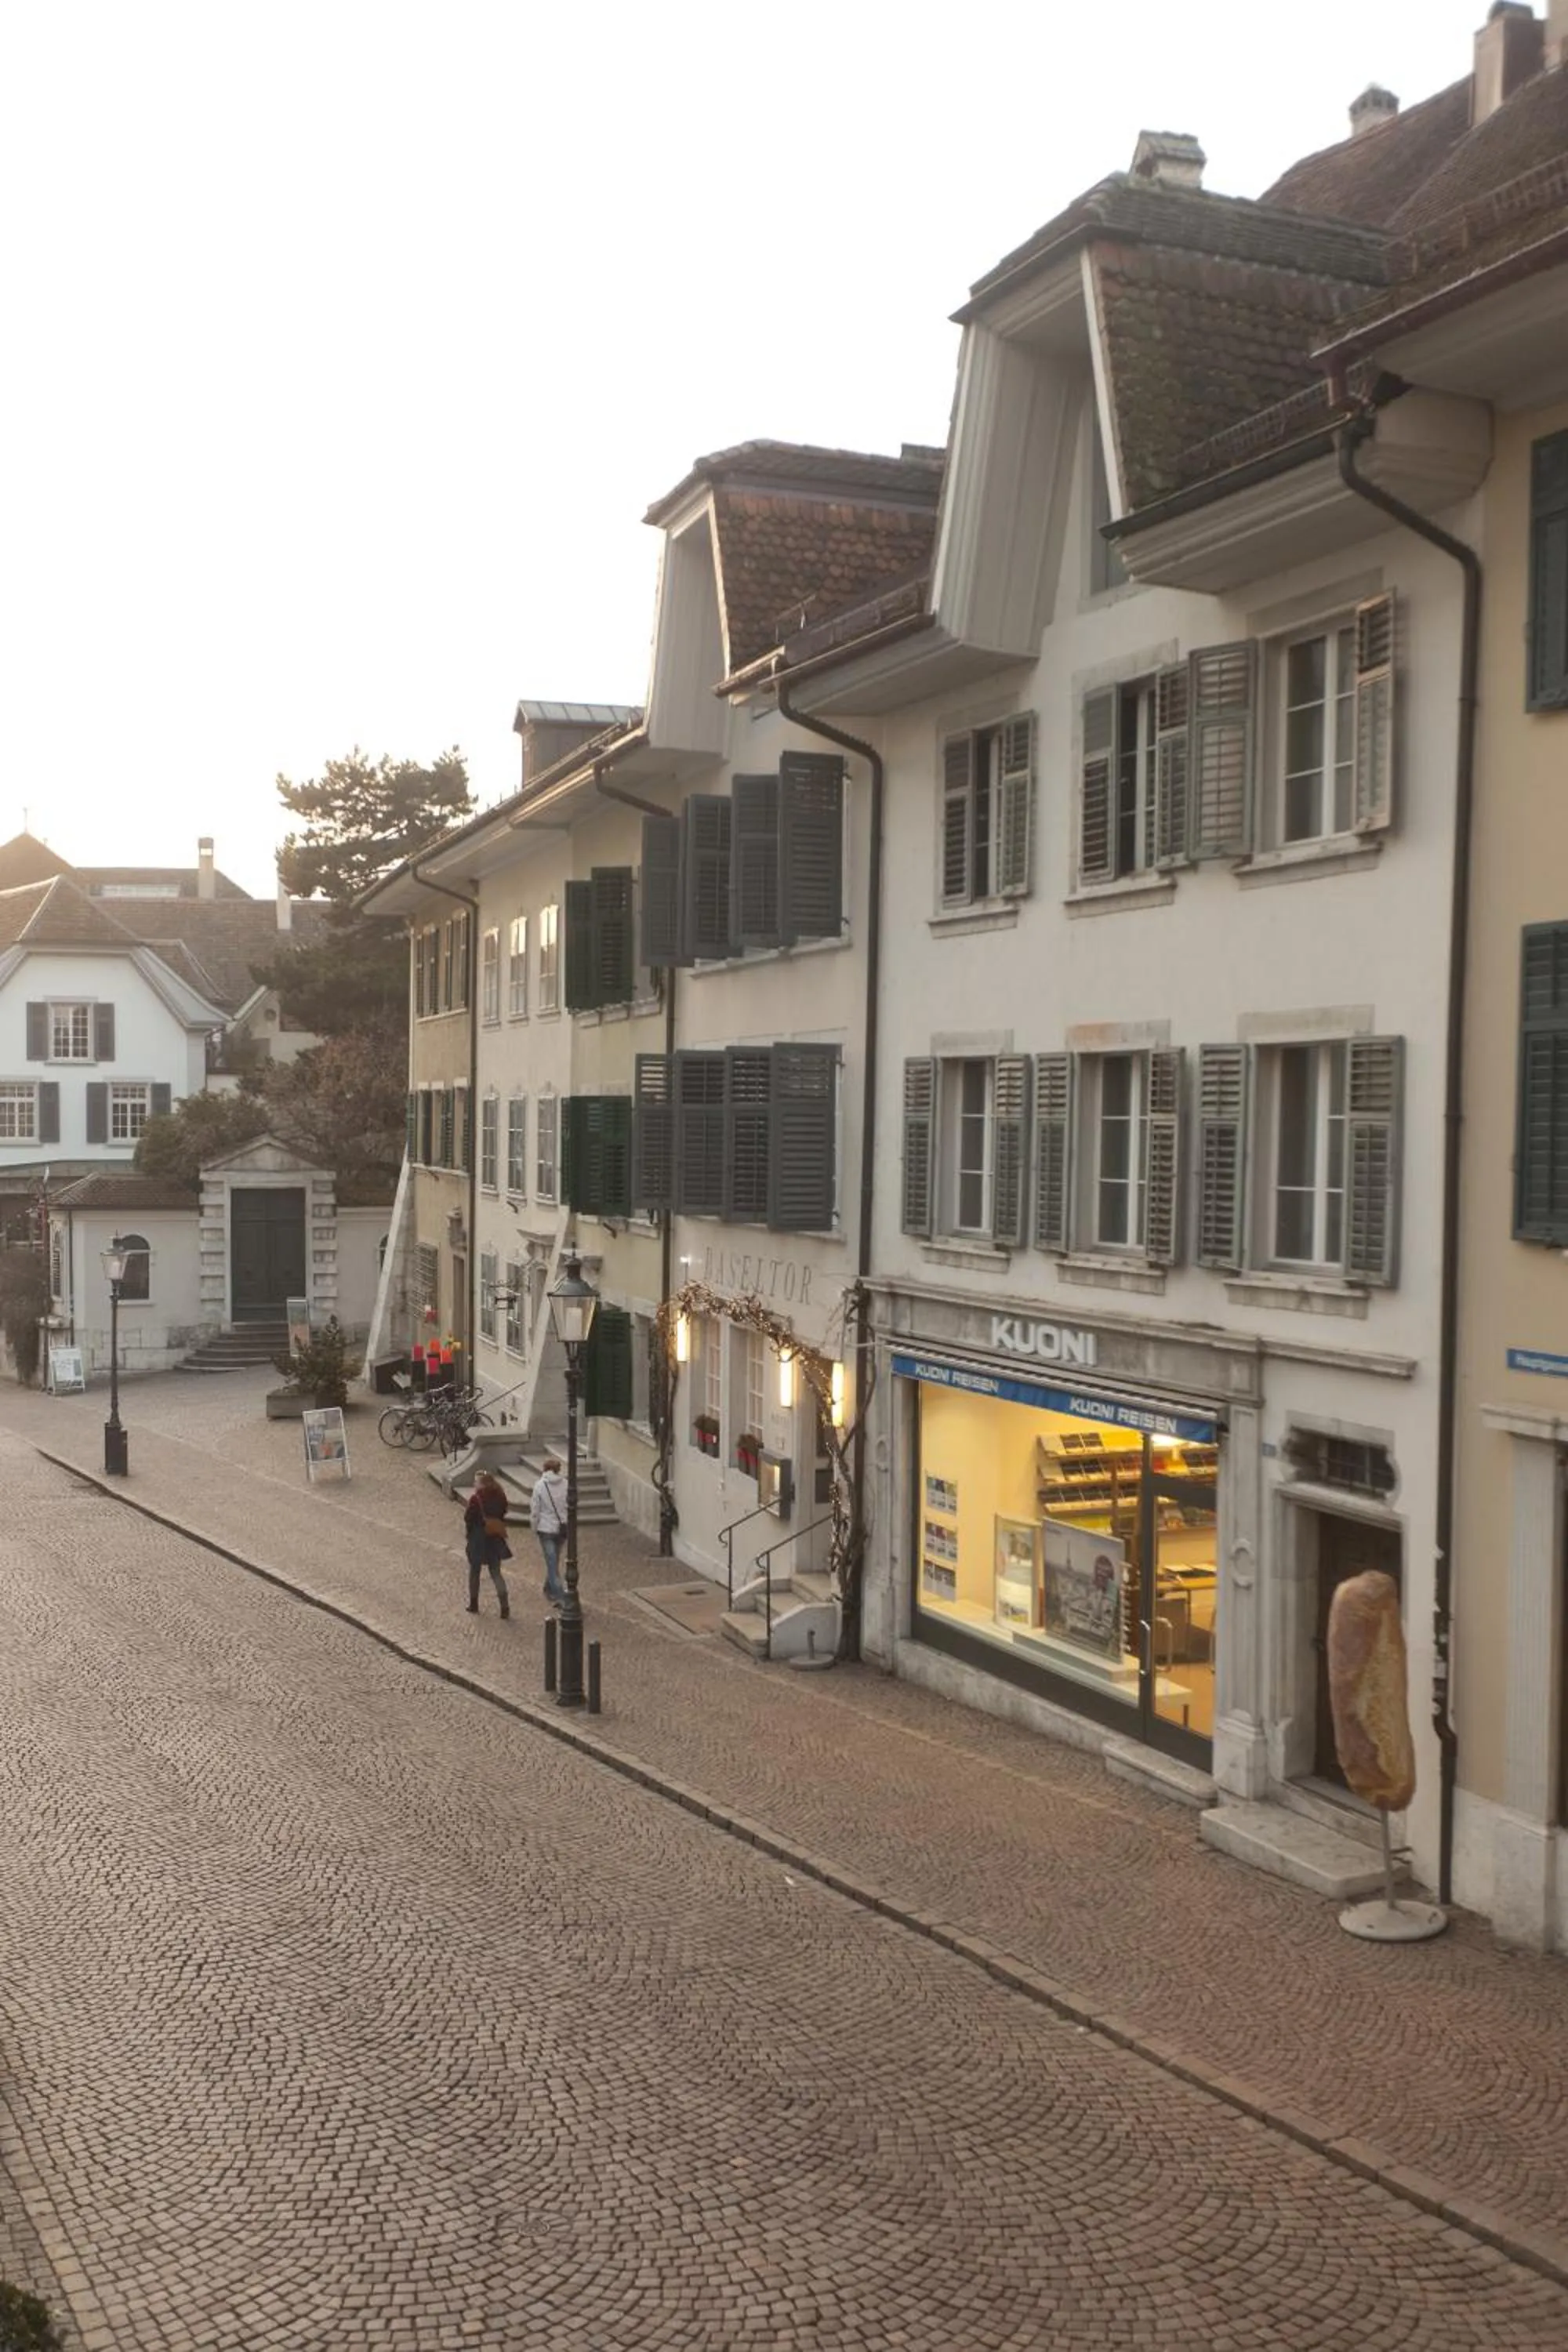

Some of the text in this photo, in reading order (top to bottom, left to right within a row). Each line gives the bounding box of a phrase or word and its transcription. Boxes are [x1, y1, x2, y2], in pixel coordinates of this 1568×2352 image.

[704, 1246, 811, 1305] BASELTOR
[991, 1316, 1096, 1365] KUONI
[915, 1363, 1000, 1393] KUONI REISEN
[1069, 1396, 1178, 1433] KUONI REISEN
